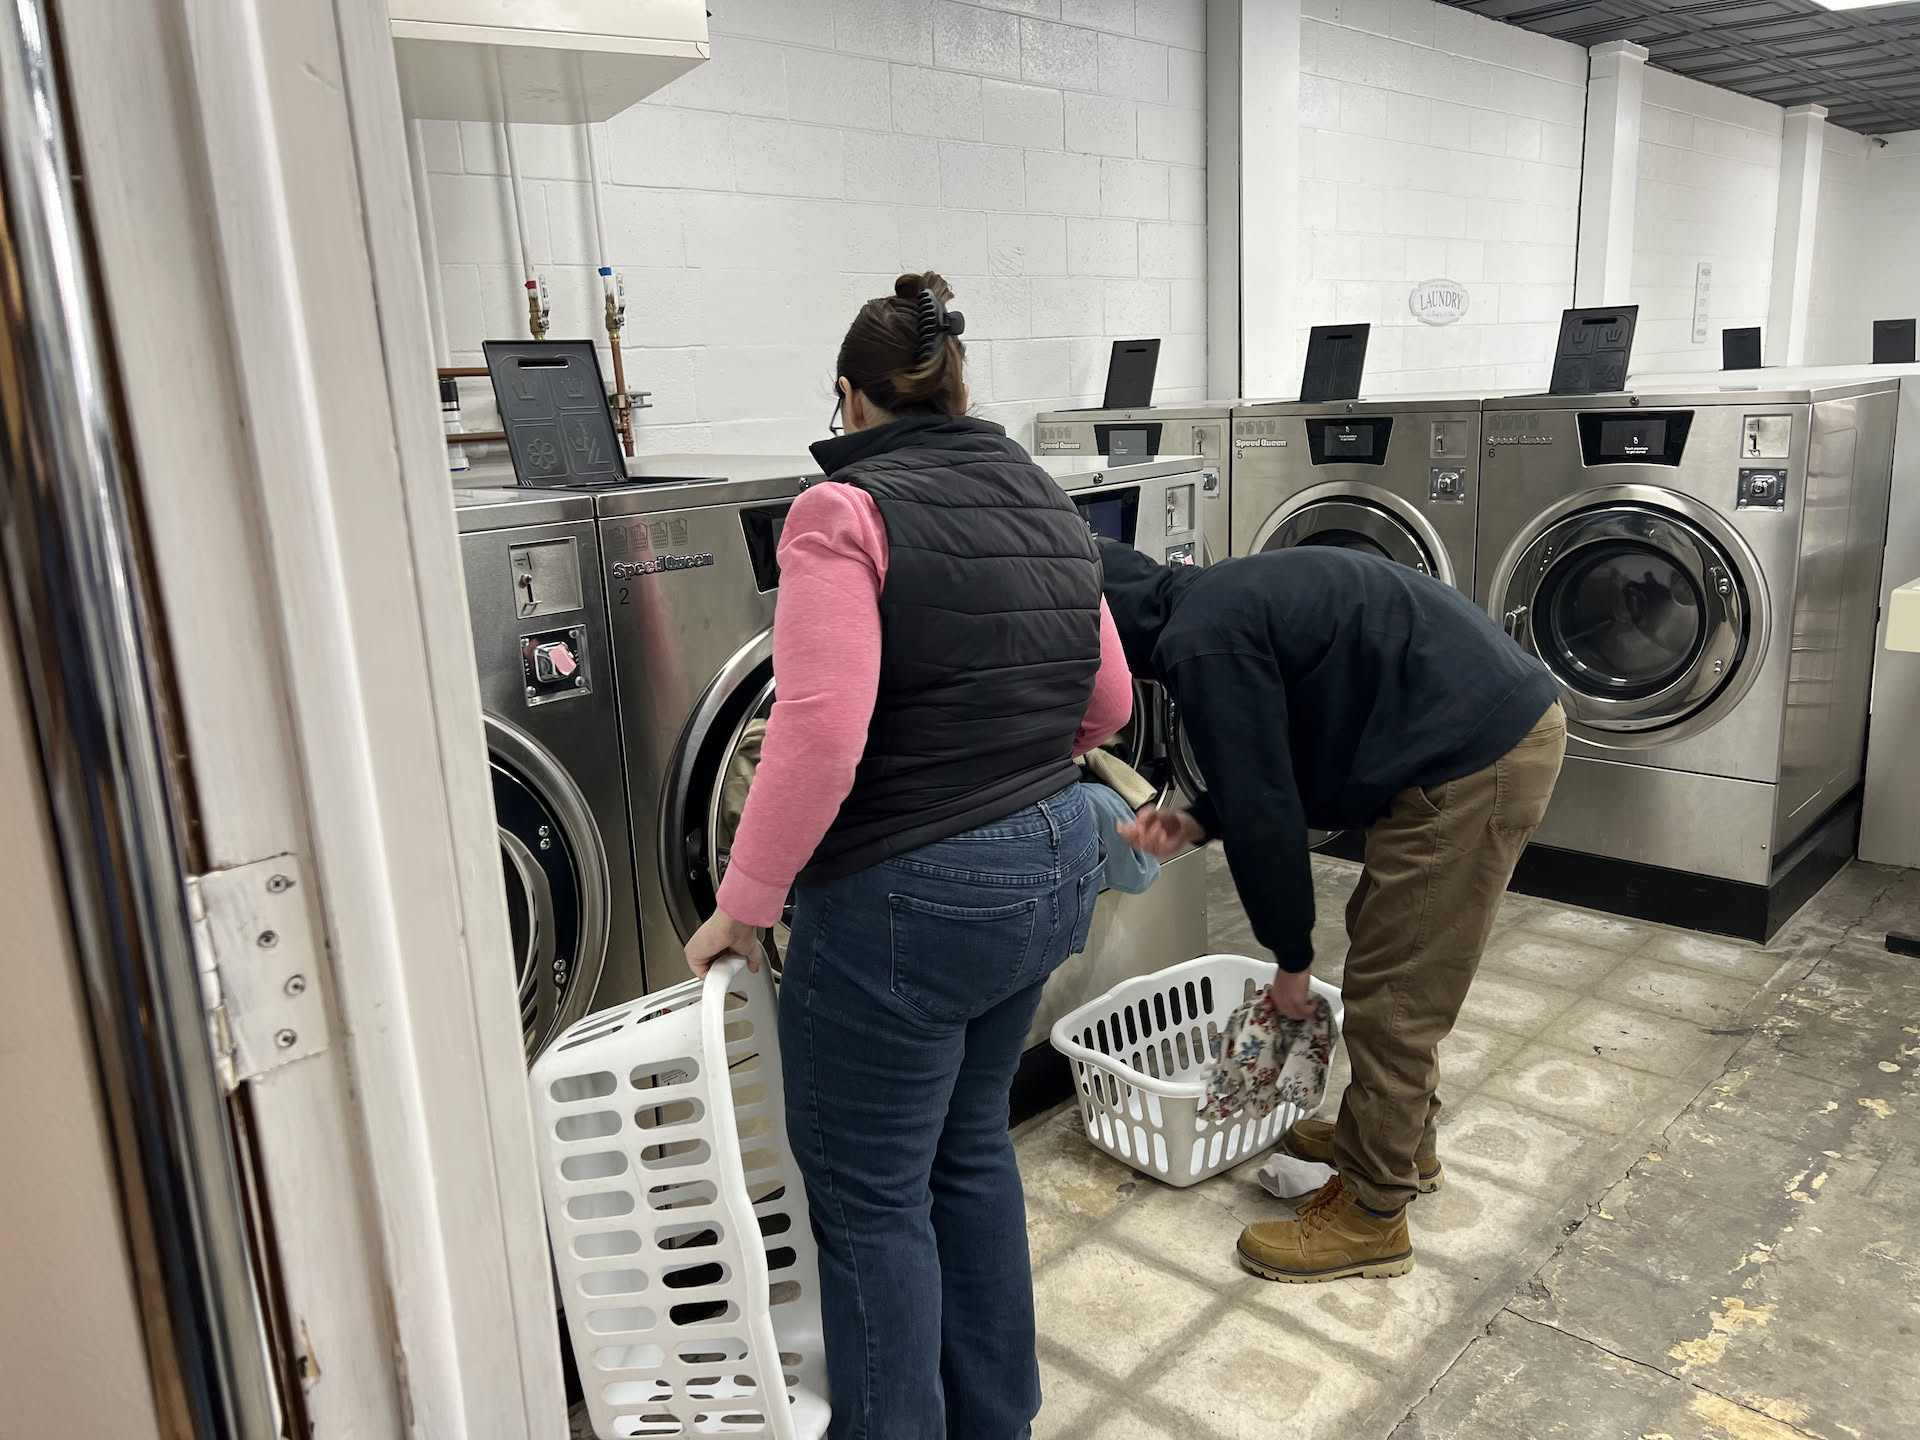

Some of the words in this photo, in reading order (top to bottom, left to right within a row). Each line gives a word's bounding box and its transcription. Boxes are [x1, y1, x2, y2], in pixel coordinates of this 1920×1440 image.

[1420, 290, 1463, 310] LAUNDRY
[1235, 438, 1260, 449] Speed
[1260, 438, 1287, 448] Queen
[1237, 450, 1243, 460] 5
[1488, 448, 1495, 458] 6
[612, 556, 665, 581] Speed
[664, 552, 714, 570] Queen
[619, 587, 630, 605] 2
